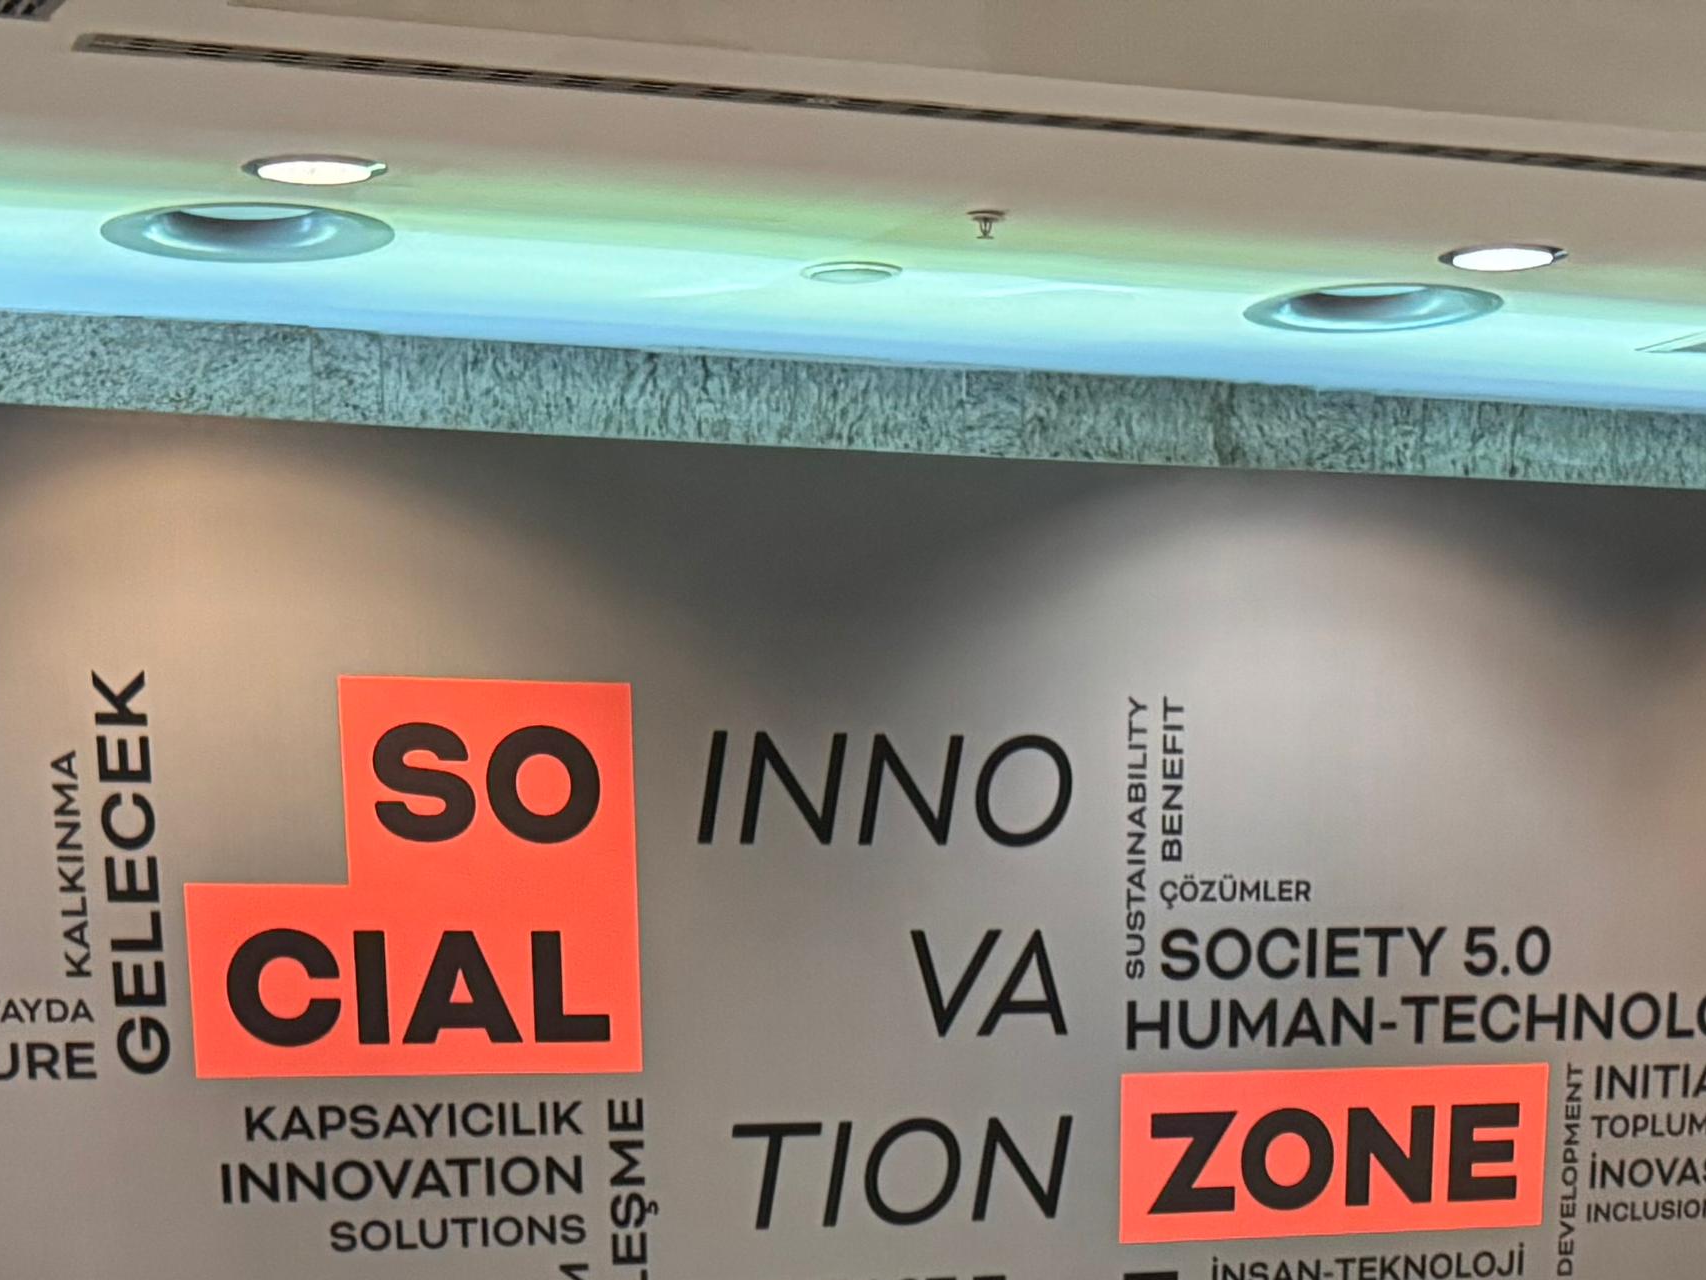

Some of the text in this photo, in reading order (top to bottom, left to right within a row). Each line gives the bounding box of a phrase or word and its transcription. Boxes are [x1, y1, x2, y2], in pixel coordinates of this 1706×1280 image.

[372, 721, 602, 844] SO
[697, 730, 1072, 846] INNO
[1161, 696, 1185, 862] BENEFIT
[51, 748, 94, 979] KALKINMA
[92, 669, 172, 1075] GELECEK
[1126, 696, 1148, 979] SUSTAINABILITY
[1159, 877, 1311, 909] ÇÖZÜMLER
[226, 928, 611, 1048] CIAL
[910, 929, 1068, 1038] VA
[1159, 924, 1552, 981] SOCIETY 5.0
[244, 1099, 584, 1142] KAPSAYICILIK
[731, 1115, 1074, 1230] TION
[1147, 1103, 1521, 1214] ZONE
[1558, 1063, 1584, 1276] DEVELOPMENT
[221, 1155, 584, 1204] INNOVATION
[329, 1214, 587, 1253] SOLUTIONS
